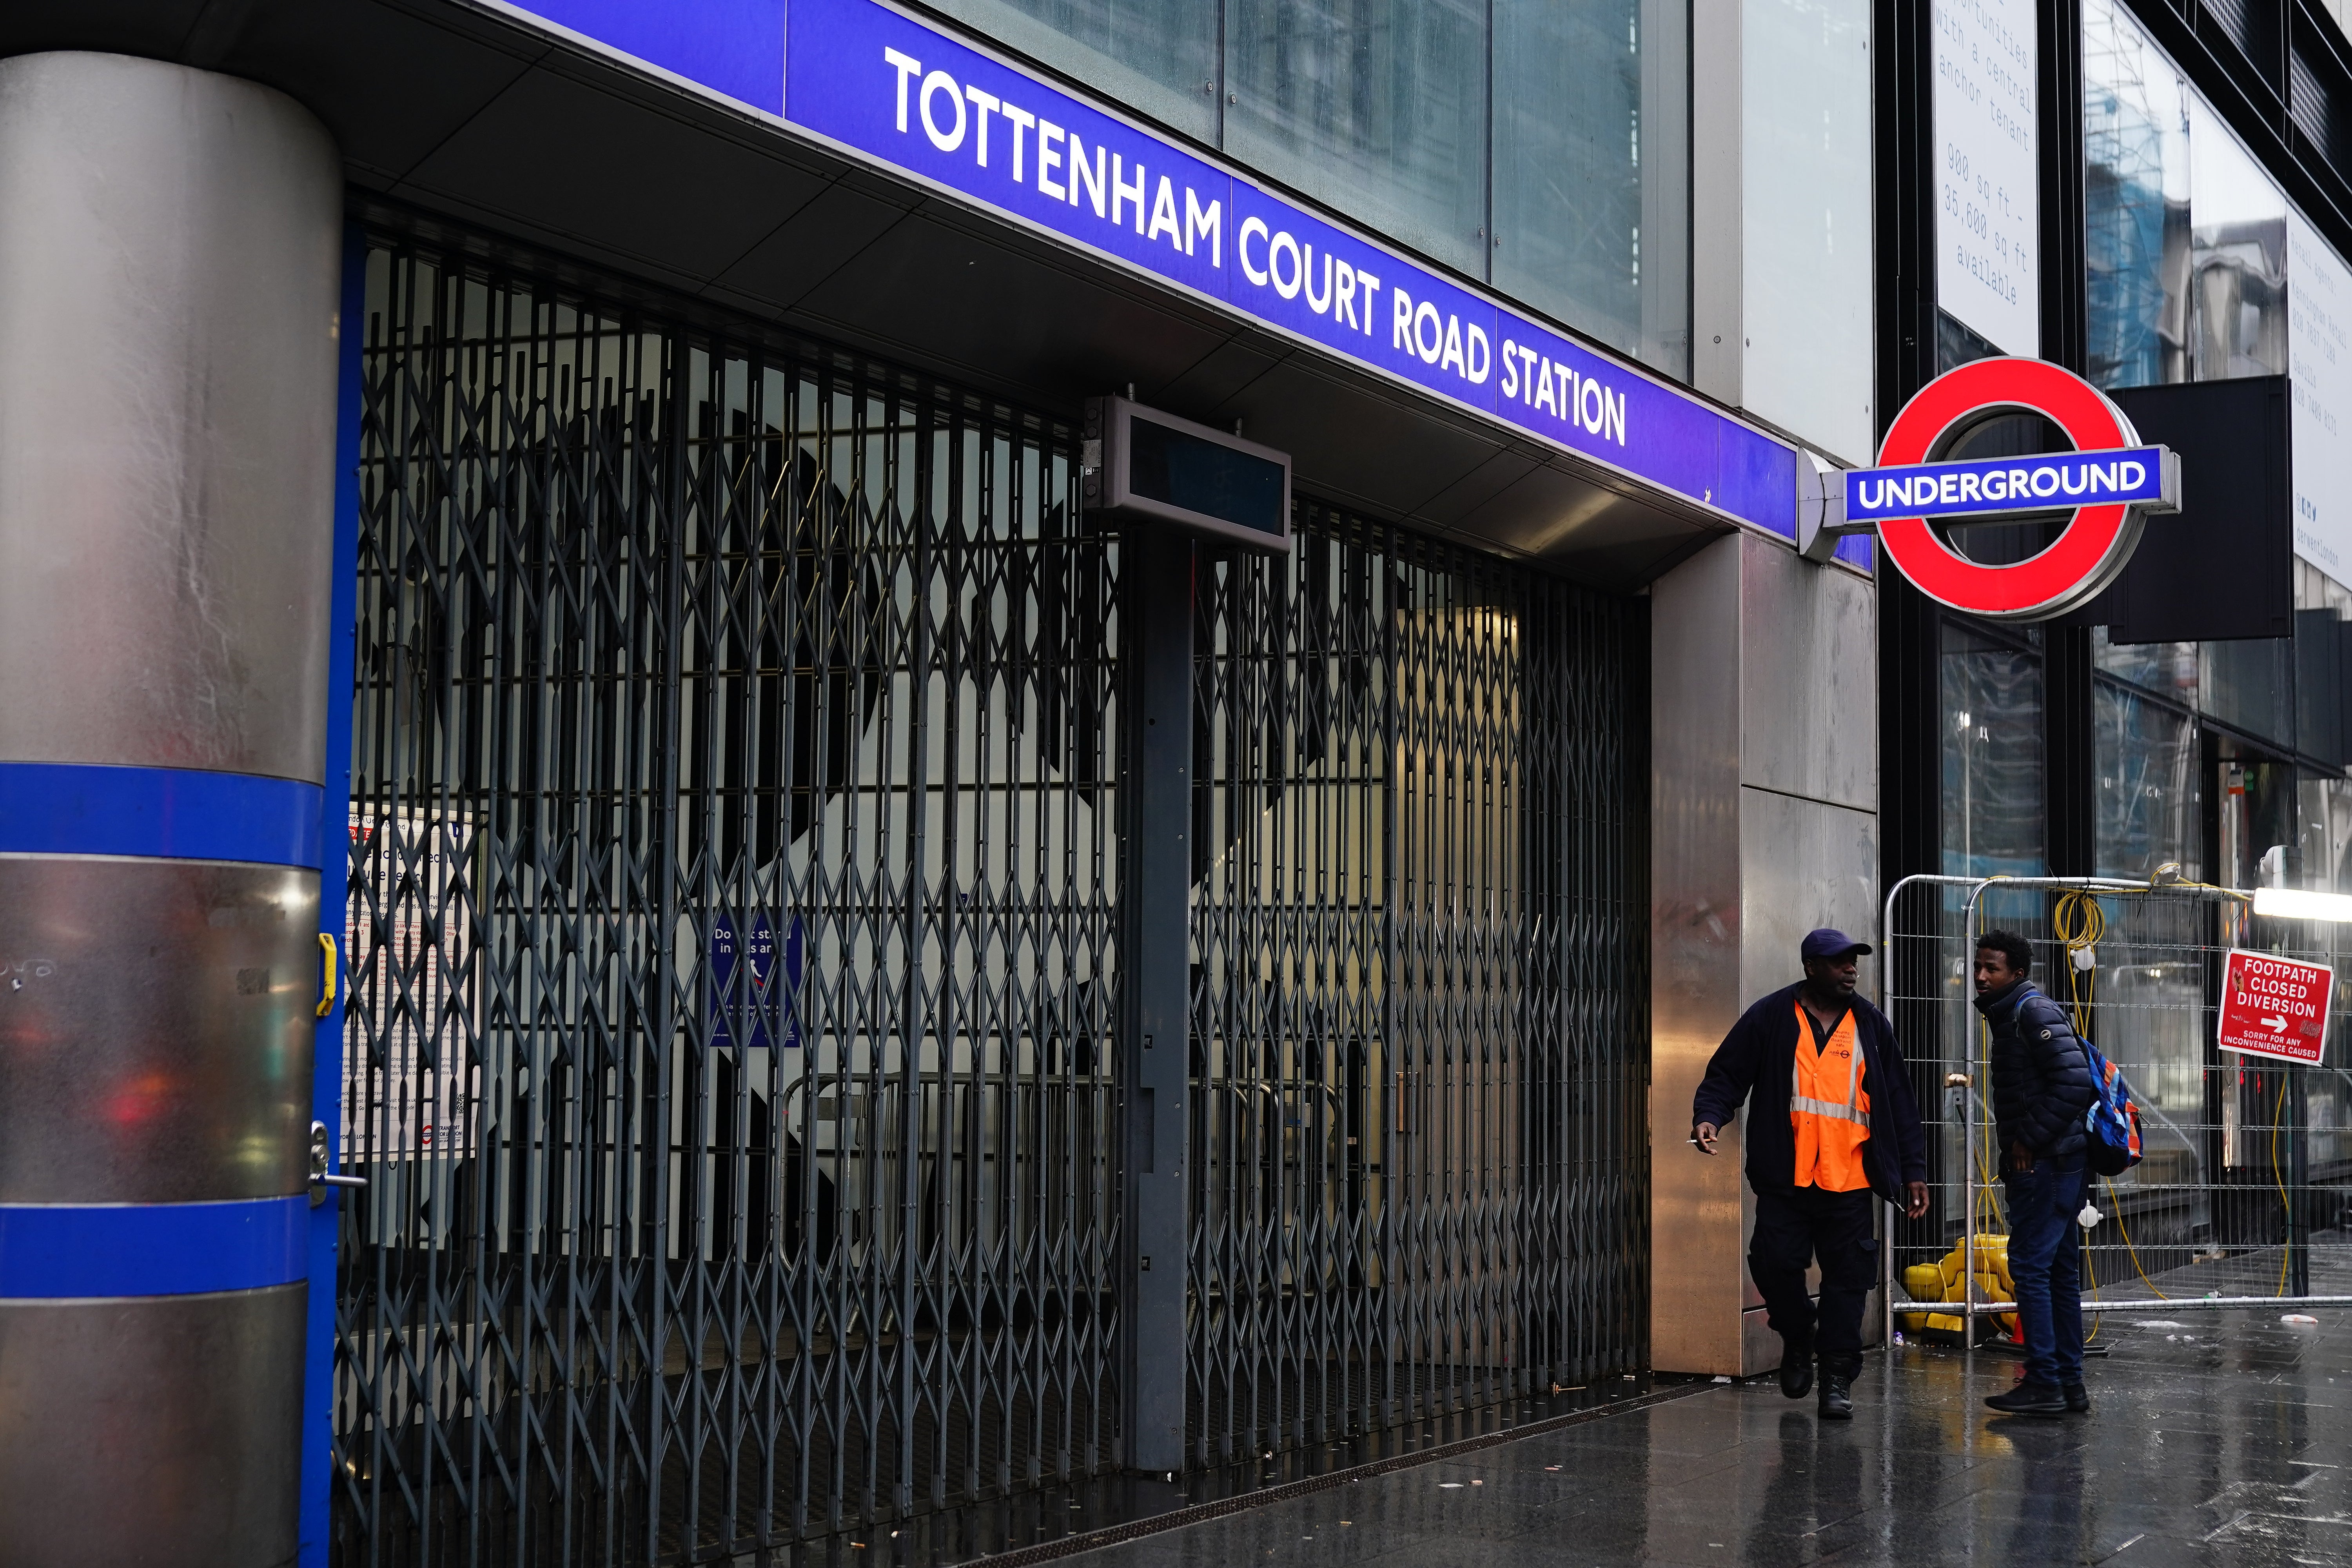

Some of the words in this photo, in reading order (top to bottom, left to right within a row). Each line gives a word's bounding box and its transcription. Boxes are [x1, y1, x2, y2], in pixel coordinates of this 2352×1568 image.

[1936, 5, 1964, 49] with
[1973, 43, 1978, 64] a
[1987, 56, 2031, 114] central
[1940, 54, 1981, 105] anchor
[1990, 96, 2028, 151] tenant
[1948, 143, 1969, 181] 900
[1978, 175, 1989, 207] sq
[1998, 187, 2009, 217] ft
[885, 46, 1221, 268] TOTTENHAM
[1239, 216, 1380, 336] COURT
[1394, 286, 1490, 384] ROAD
[1501, 338, 1626, 446] STATION
[1945, 184, 1986, 240] 35,600
[1995, 232, 2007, 263] sq
[2015, 242, 2026, 272] ft
[1958, 245, 2016, 305] available
[2291, 232, 2312, 270] Retail
[2315, 261, 2336, 297] agents:
[2293, 307, 2303, 333] 020
[2328, 314, 2347, 350] Retail
[2294, 352, 2316, 389] Savills
[2294, 382, 2305, 408] 020
[1858, 461, 2146, 509] UNDERGROUND
[2297, 523, 2339, 568] derwentlondon
[715, 928, 731, 939] Do
[720, 943, 731, 953] in
[2245, 958, 2317, 984] FOOTPATH
[2250, 977, 2307, 999] CLOSED
[2237, 992, 2316, 1018] DIVERSION
[2224, 1035, 2286, 1053] INCONVENIENCE
[2288, 1047, 2317, 1058] CAUSED
[2243, 1030, 2268, 1041] SORRY
[2270, 1034, 2284, 1043] FOR
[2286, 1037, 2301, 1046] ANY
